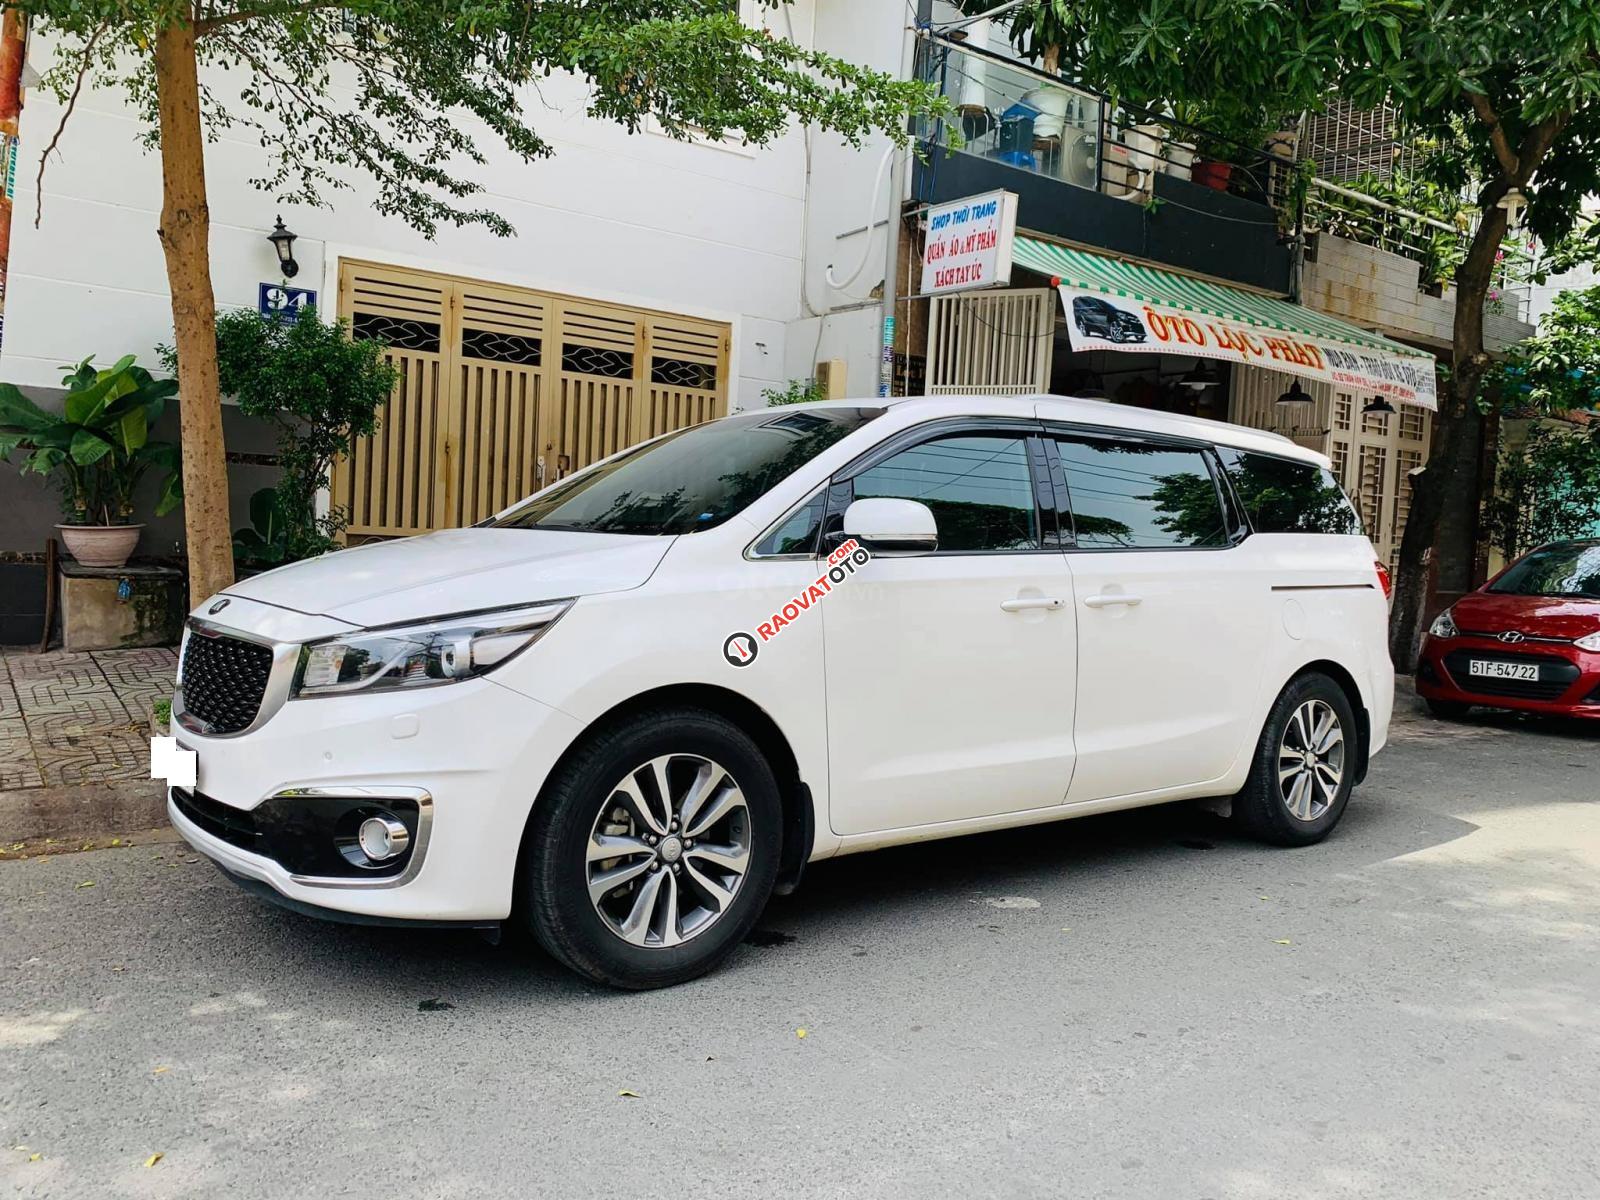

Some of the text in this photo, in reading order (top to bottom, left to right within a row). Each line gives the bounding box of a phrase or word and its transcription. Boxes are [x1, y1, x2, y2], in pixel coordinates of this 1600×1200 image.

[931, 213, 951, 231] SHOP
[971, 200, 997, 221] TRANG
[934, 266, 955, 288] XÁCH
[955, 266, 971, 284] TAY
[266, 288, 307, 312] 94
[1259, 335, 1325, 371] PHÁT
